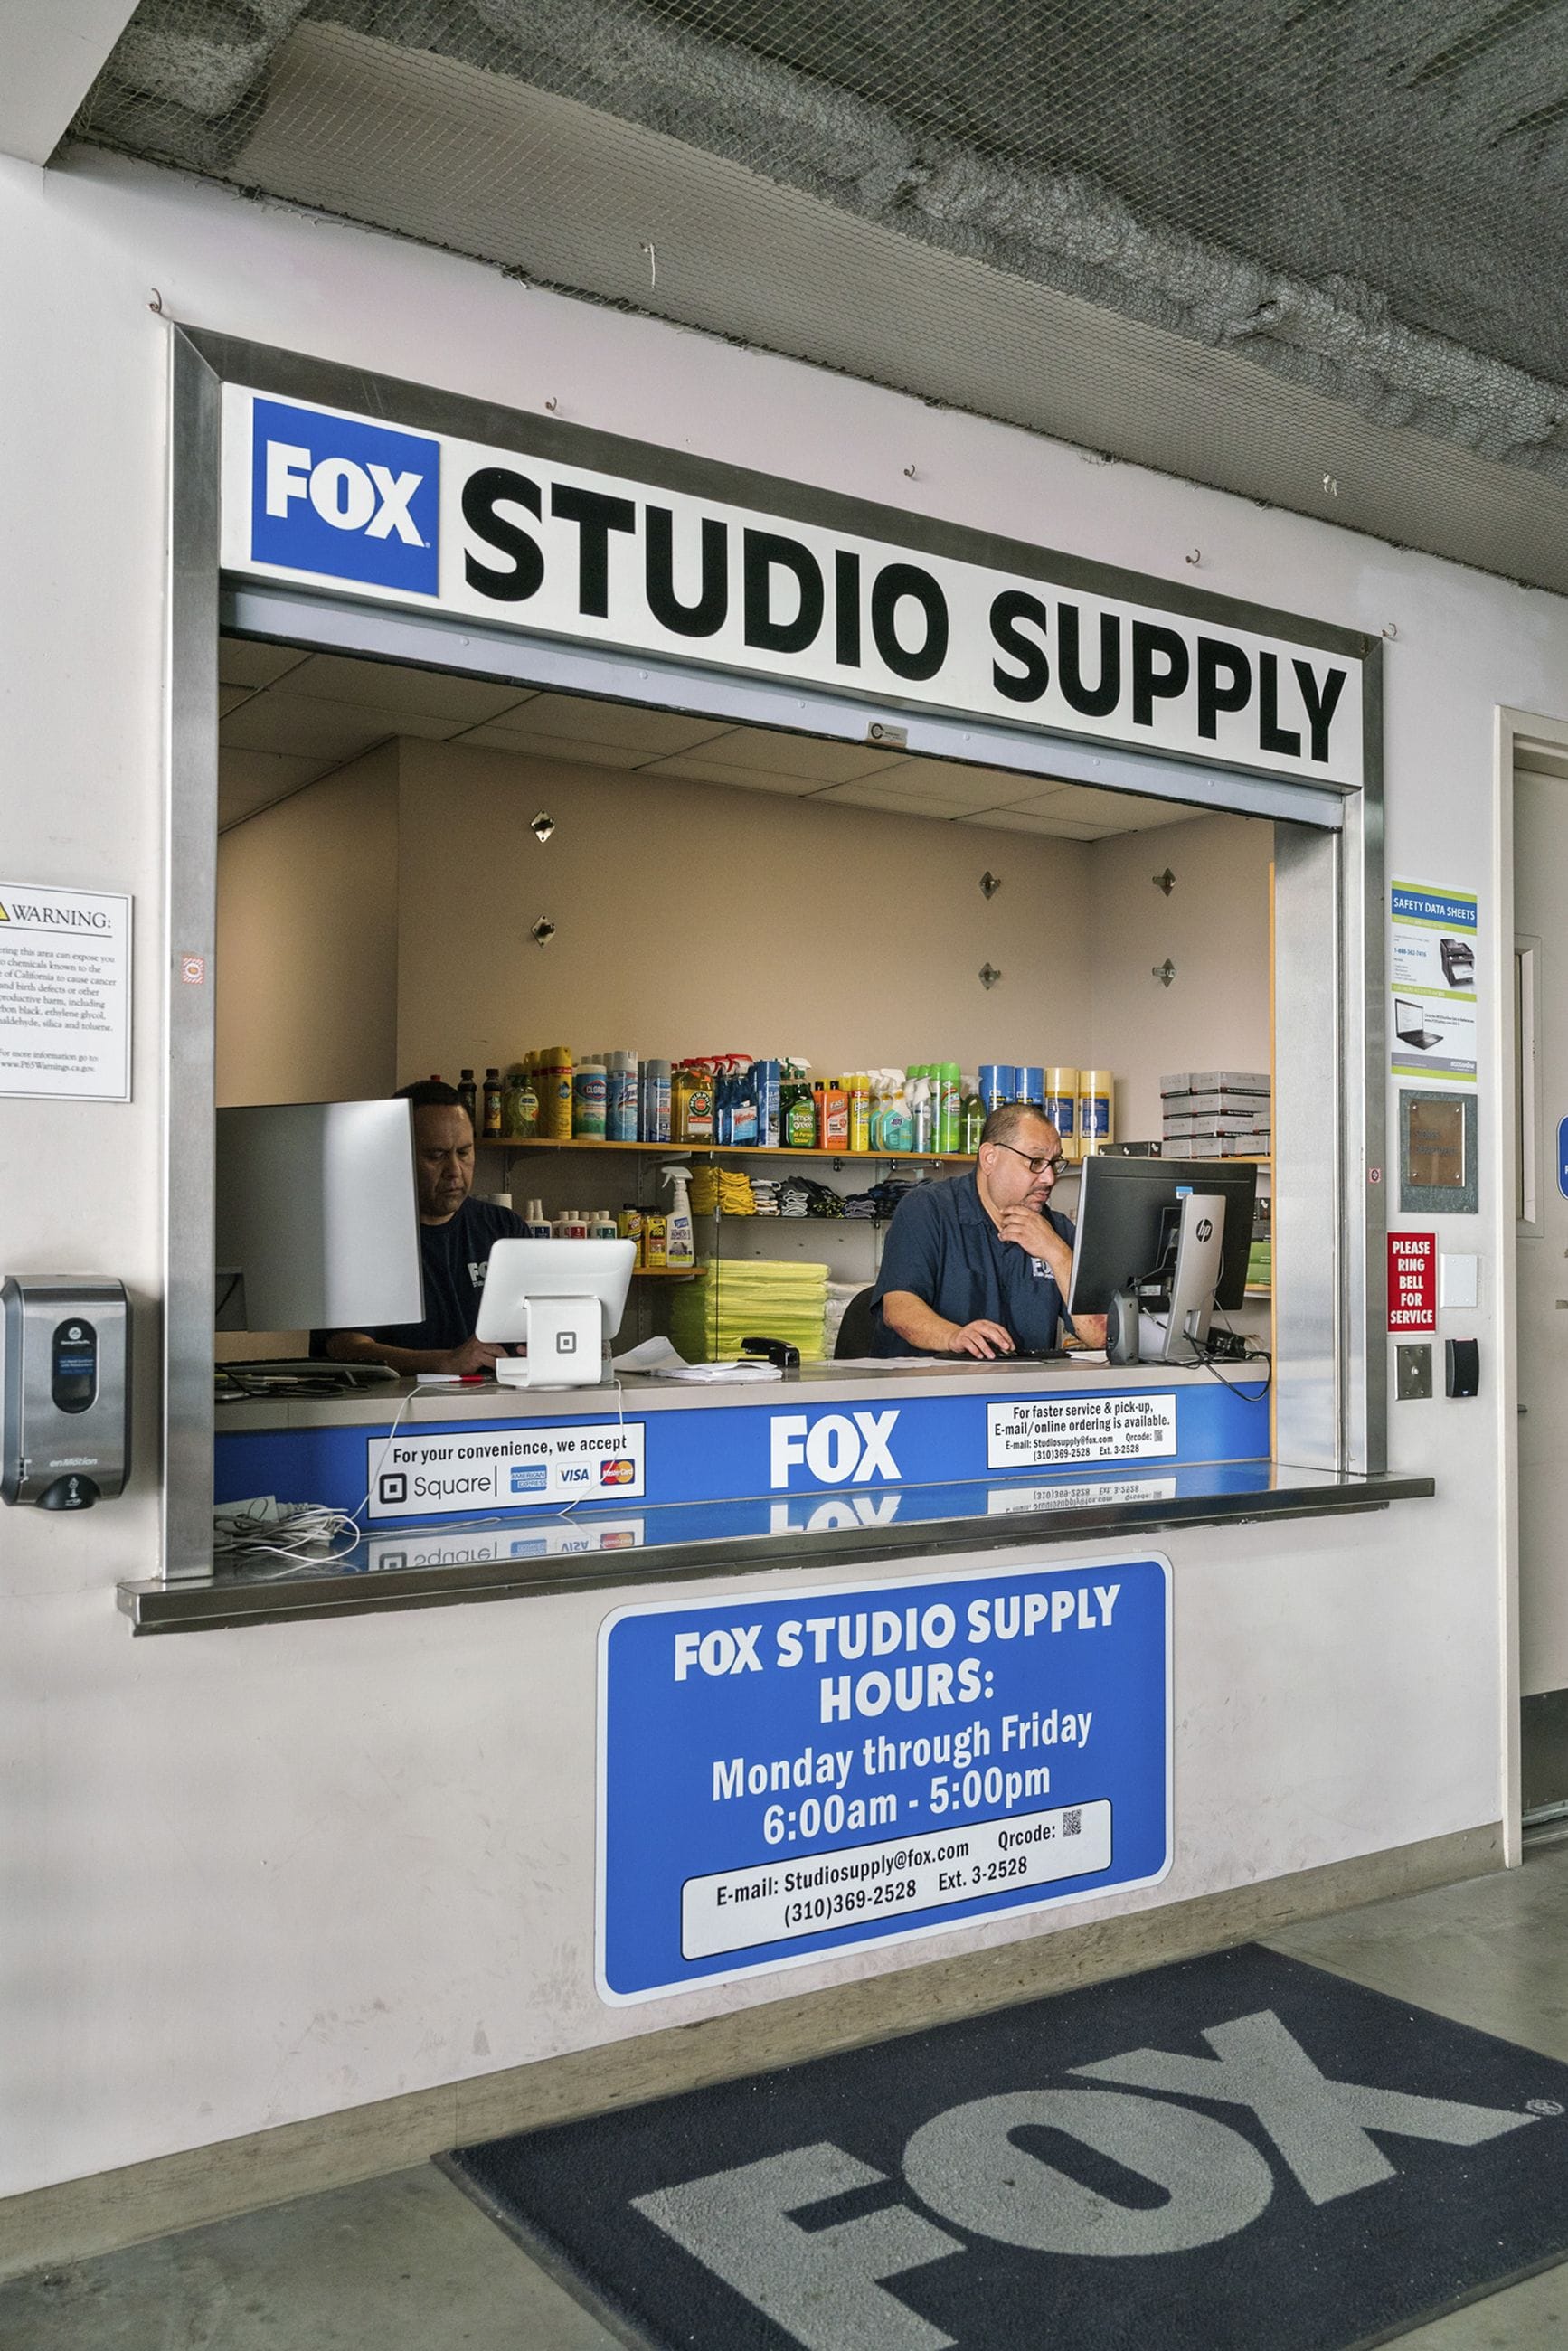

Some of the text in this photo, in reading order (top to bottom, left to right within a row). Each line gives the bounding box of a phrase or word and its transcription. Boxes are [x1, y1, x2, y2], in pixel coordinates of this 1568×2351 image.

[266, 439, 1347, 763] FOX STUDIO SUPPLY
[12, 904, 111, 929] WARNING:
[1393, 897, 1475, 921] SAFETY DATA SHEETS
[20, 947, 35, 956] this
[56, 951, 71, 959] can
[72, 954, 98, 963] expose
[100, 956, 115, 964] you
[7, 958, 47, 969] chemicals
[49, 960, 76, 971] known
[78, 964, 86, 972] to
[89, 965, 101, 973] the
[4, 969, 14, 977] of
[14, 969, 54, 981] California
[56, 974, 65, 982] to
[15, 982, 36, 992] birth
[38, 983, 65, 994] defects
[78, 987, 99, 996] other
[69, 998, 105, 1009] including
[64, 1021, 80, 1030] and
[1393, 1241, 1431, 1255] PLEASE
[467, 1261, 489, 1281] FO
[1398, 1258, 1425, 1272] RING
[1399, 1275, 1424, 1289] BELL
[1401, 1292, 1422, 1307] FOR
[1390, 1309, 1433, 1325] SERVICE
[1013, 1400, 1153, 1419] For faster service & pick-up,
[995, 1414, 1170, 1437] E-mail/online ordering is available.
[770, 1410, 902, 1489] FOX
[1006, 1432, 1152, 1450] E-mail: Studiosupply@fox.com Qrcode:
[393, 1436, 627, 1465] For your convenience, we accept
[1034, 1444, 1139, 1462] (310)369-2528 Ext. 3-2528
[511, 1470, 546, 1479] AMERICAN
[518, 1479, 547, 1488] EXPRESS
[561, 1469, 589, 1482] VISA
[414, 1477, 491, 1500] Square
[675, 1583, 1121, 1682] FOX STUDIO SUPPLY
[820, 1657, 995, 1723] HOURS:
[713, 1711, 1092, 1802] Monday through Friday
[763, 1793, 897, 1845] 6:00am
[930, 1767, 1051, 1816] 5:00pm
[716, 1824, 1056, 1907] E-mail: Studiosupply@fox.com Qrcode:
[784, 1856, 1027, 1929] (310)369-2528 Ext. 3-2528
